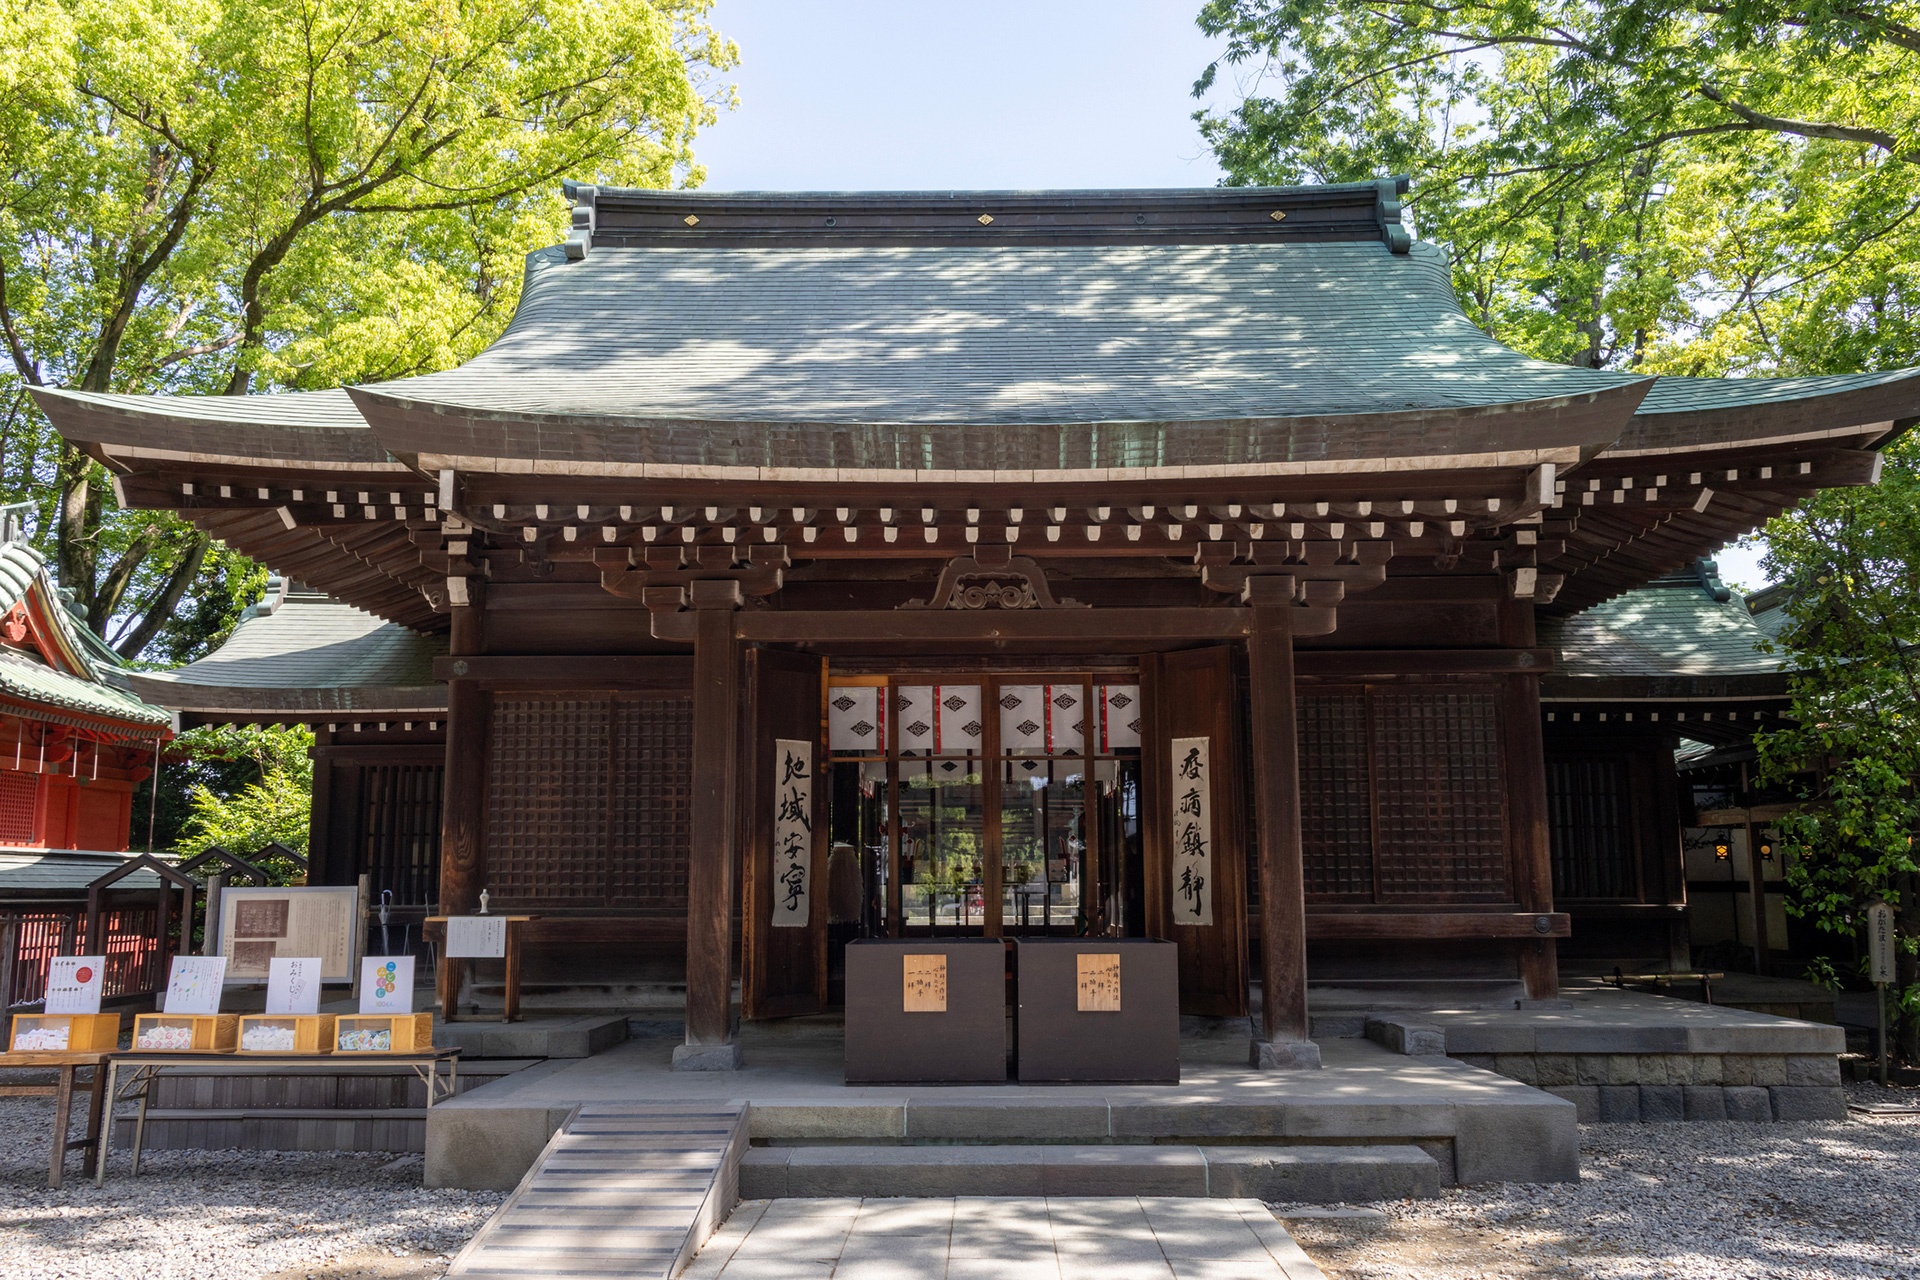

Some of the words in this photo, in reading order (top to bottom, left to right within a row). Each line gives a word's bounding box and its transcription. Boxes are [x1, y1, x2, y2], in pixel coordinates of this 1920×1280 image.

[778, 750, 811, 912] 地域安寧
[1177, 747, 1209, 917] 疫病鎮静
[289, 961, 298, 994] おみくじ
[907, 971, 915, 990] 一拝
[916, 970, 924, 997] 二拍手
[925, 970, 932, 989] 二拝
[1080, 971, 1088, 990] 一拝
[1097, 970, 1105, 990] 二拝
